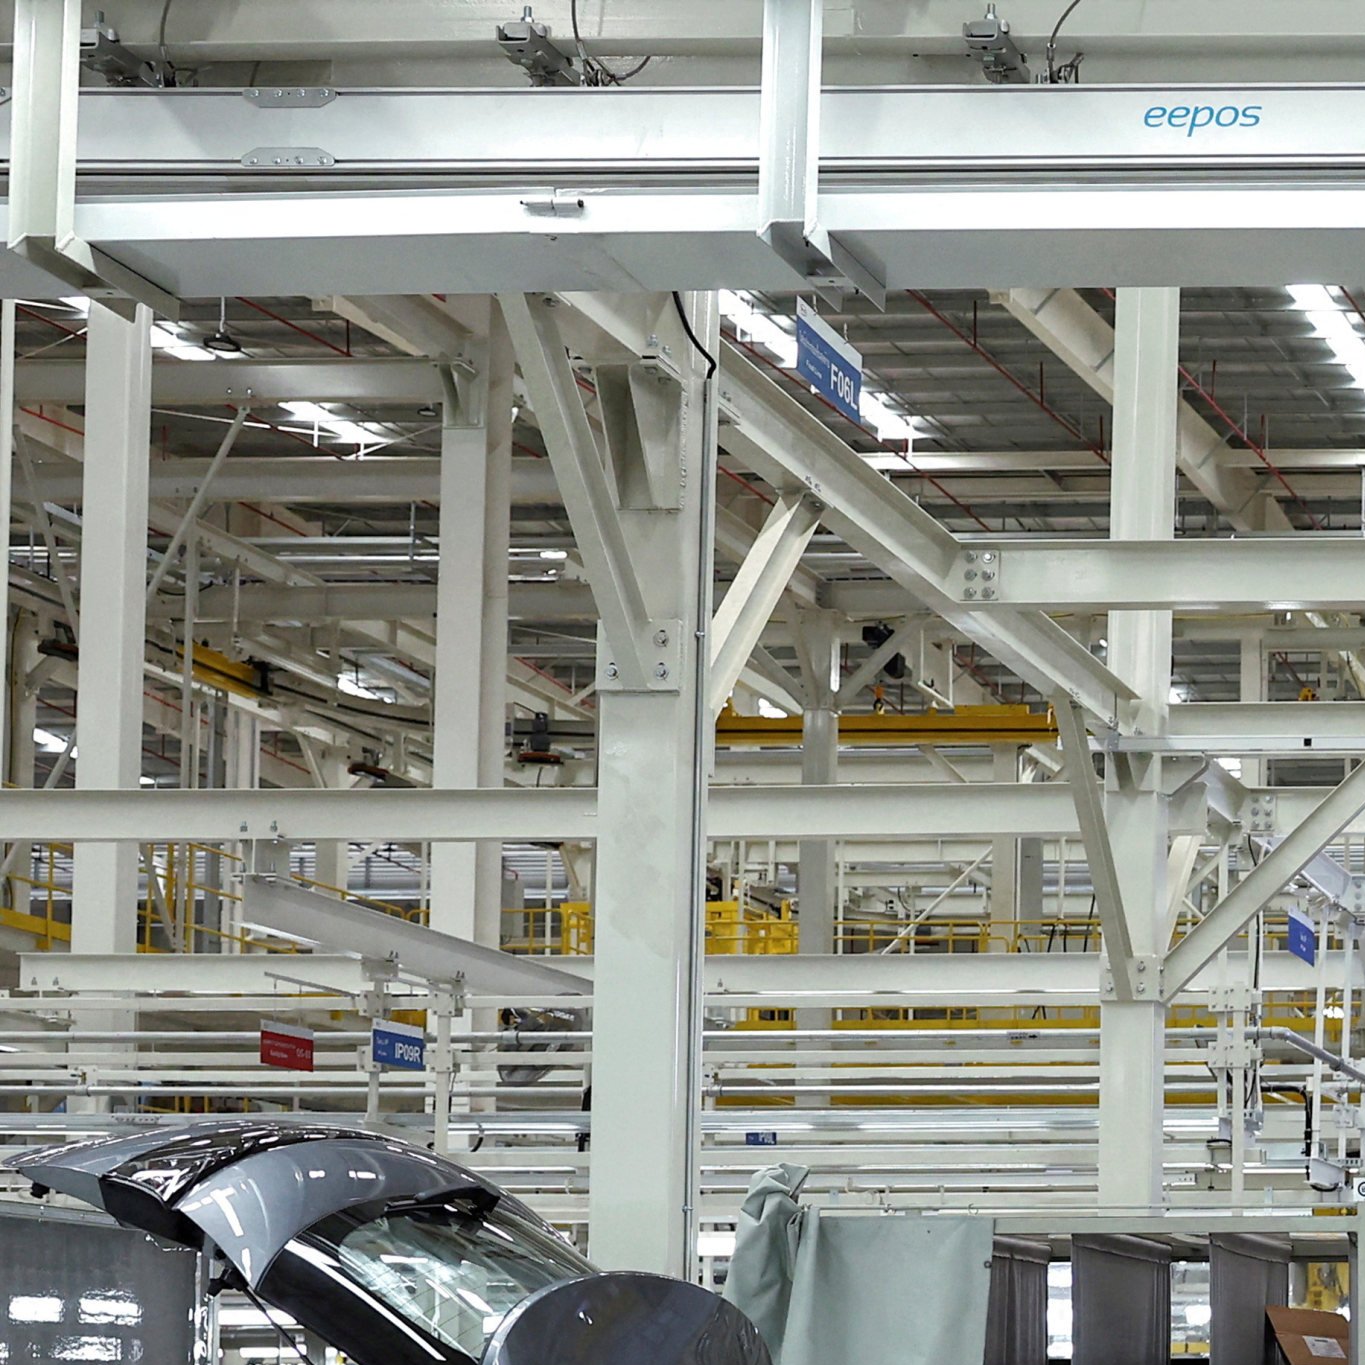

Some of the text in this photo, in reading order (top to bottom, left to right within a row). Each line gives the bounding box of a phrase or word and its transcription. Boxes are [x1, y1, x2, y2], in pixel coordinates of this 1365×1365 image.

[1143, 105, 1263, 138] eepos
[830, 362, 858, 410] F06L
[394, 1042, 421, 1064] IP09R
